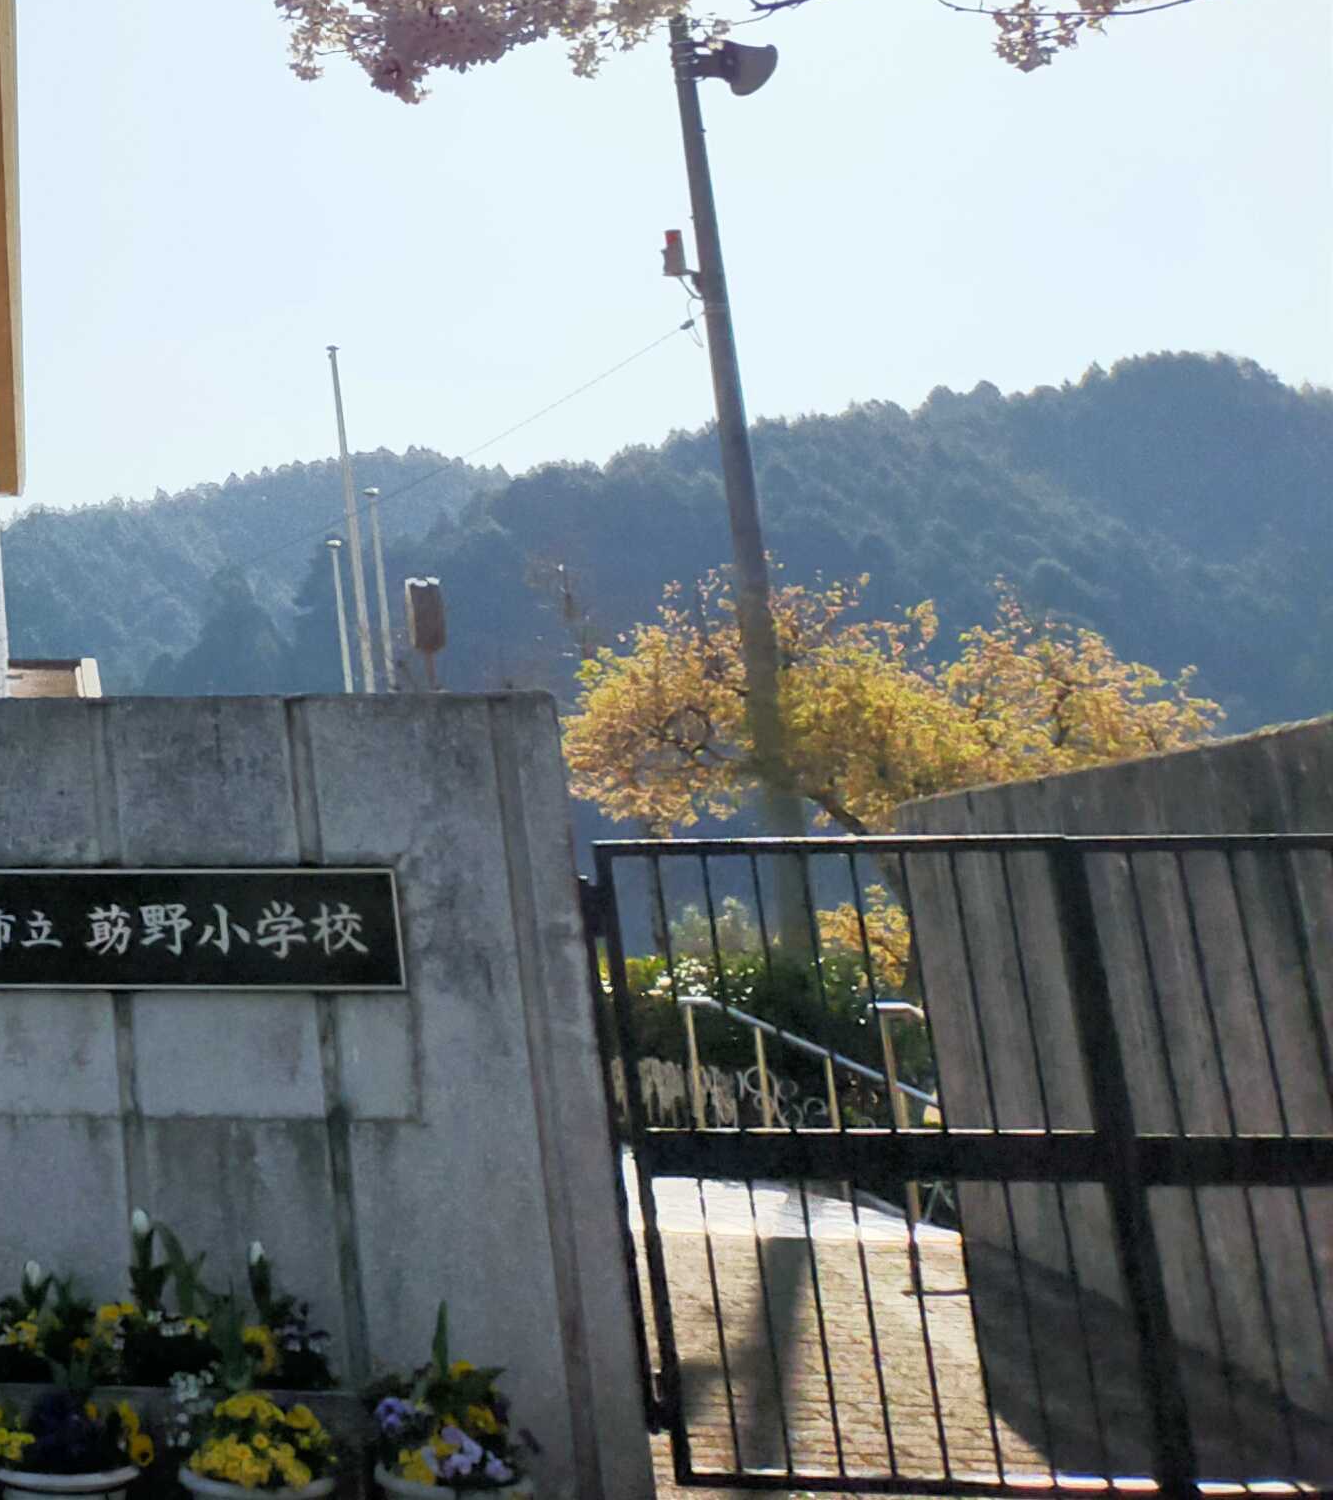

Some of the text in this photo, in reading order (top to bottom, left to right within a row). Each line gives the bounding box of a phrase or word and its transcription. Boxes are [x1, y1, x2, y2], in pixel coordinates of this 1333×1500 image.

[85, 902, 370, 959] 莇野小学校
